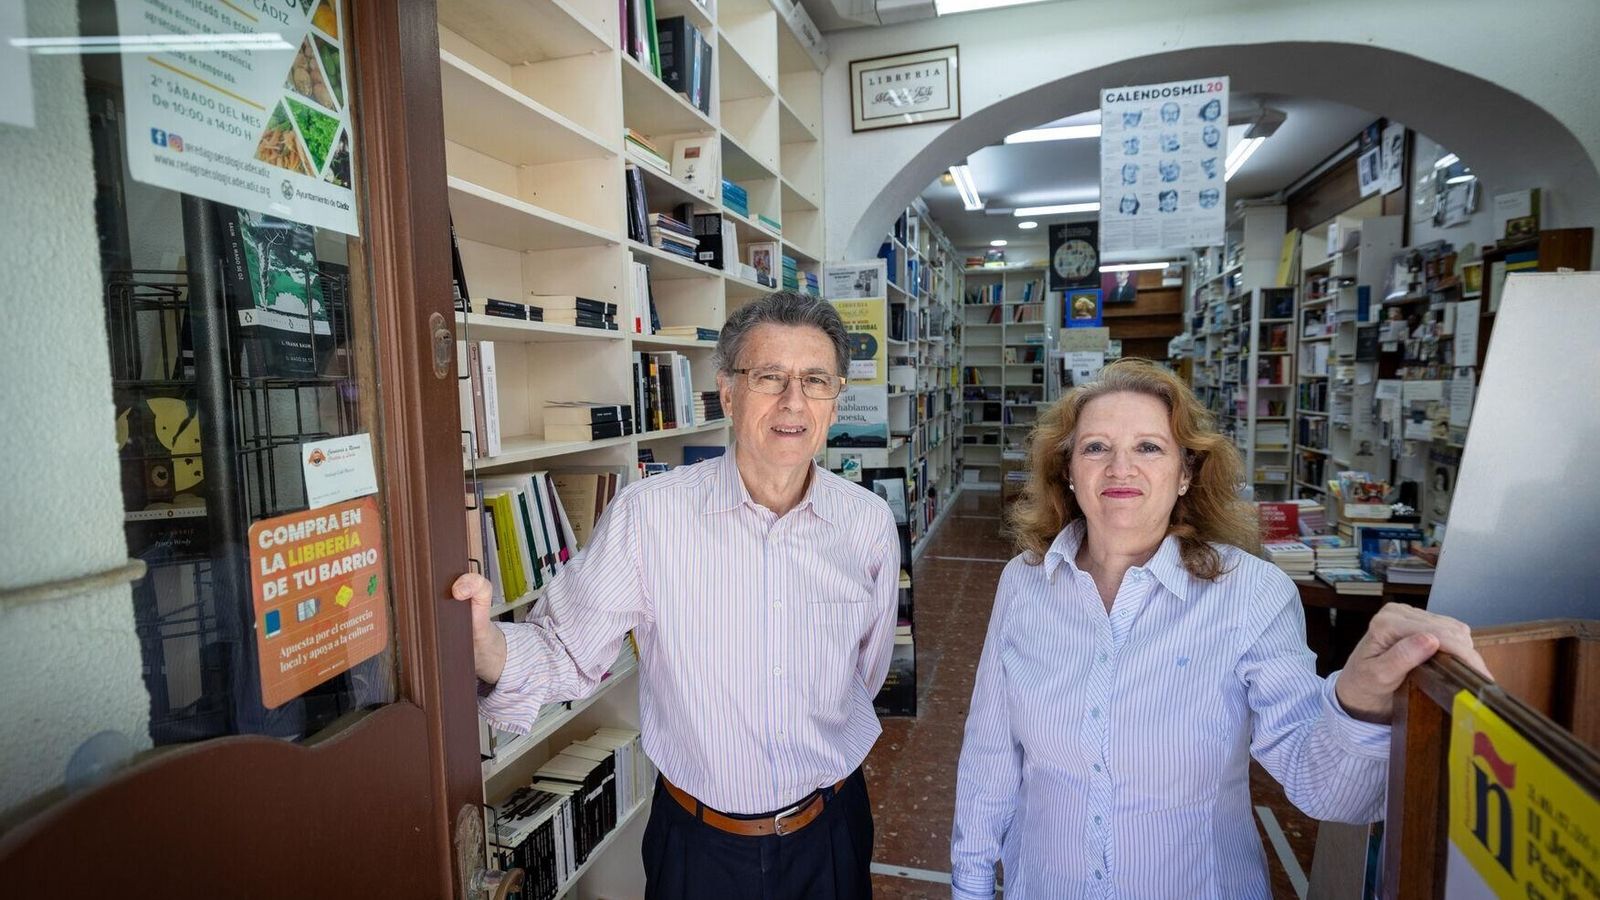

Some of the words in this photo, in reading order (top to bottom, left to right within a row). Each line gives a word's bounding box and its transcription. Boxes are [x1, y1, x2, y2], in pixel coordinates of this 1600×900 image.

[167, 80, 215, 110] SÁBADO
[218, 103, 239, 120] DEL
[241, 112, 261, 128] MES
[1105, 82, 1224, 103] CALENDOSMIL20
[258, 513, 340, 549] COMPRA
[341, 508, 362, 528] EN
[260, 552, 287, 577] LA
[287, 528, 362, 568] LIBRERÍA
[262, 576, 289, 601] DE
[292, 567, 317, 590] TU
[318, 548, 378, 583] BARRIO
[280, 636, 315, 657] Apuesta
[315, 629, 330, 644] por
[330, 623, 339, 636] el
[339, 609, 373, 631] comercio
[280, 654, 302, 673] local
[302, 654, 309, 665] y
[309, 643, 333, 658] apoya
[340, 634, 348, 645] la
[348, 623, 374, 640] cultura
